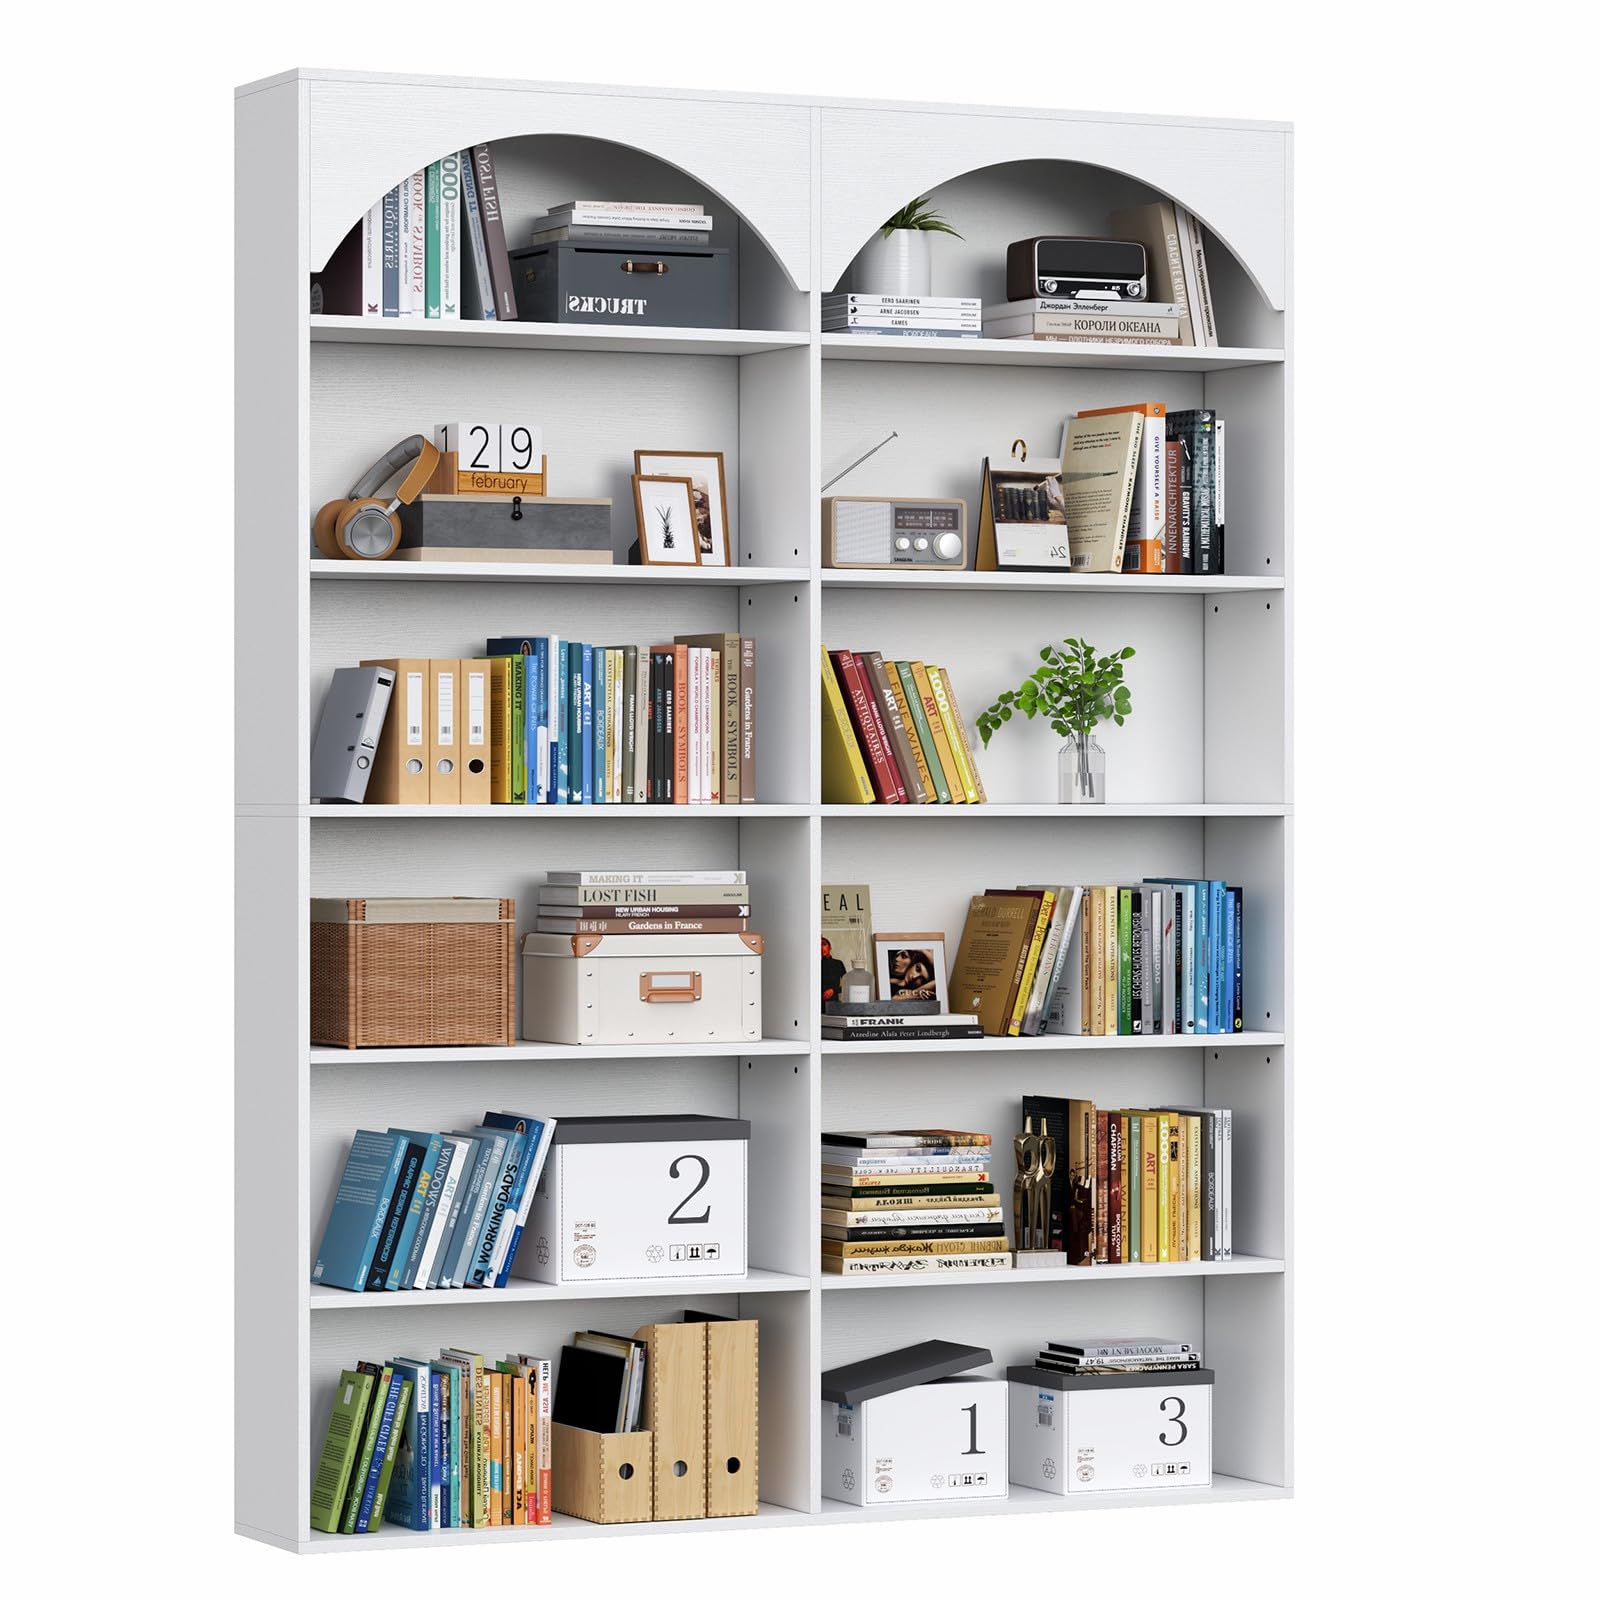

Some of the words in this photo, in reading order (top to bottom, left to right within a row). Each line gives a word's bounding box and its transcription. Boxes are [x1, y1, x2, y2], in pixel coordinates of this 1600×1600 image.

[1166, 233, 1181, 278] СПАСИТЕ
[1040, 301, 1071, 310] Джордан
[1073, 302, 1109, 312] Элленберг
[1074, 319, 1116, 332] КОРОЛИ
[1118, 320, 1161, 333] ОКЕАНА
[471, 472, 528, 494] february
[1124, 478, 1132, 512] RAYMOND
[1168, 449, 1177, 554] INNENARCHITEKTUR
[1182, 491, 1190, 526] GRAVITY'S
[1119, 514, 1128, 551] CHANDLER
[1182, 526, 1190, 559] RAINBOW
[514, 661, 522, 694] MAKING
[727, 673, 737, 708] BOOK
[928, 671, 950, 713] 1000
[515, 698, 522, 710] IT
[583, 681, 592, 708] ART
[678, 682, 686, 714] BOOK
[744, 687, 752, 720] Gardens
[882, 688, 898, 712] ART
[923, 696, 939, 717] ART
[596, 710, 605, 750] BORDEAUX
[745, 721, 752, 730] in
[854, 688, 884, 763] ANTIQUAIRES
[870, 701, 880, 719] FRANK
[882, 736, 892, 756] WRIGHT
[890, 681, 910, 719] FINE
[905, 726, 930, 785] WINES
[678, 726, 686, 783] SYMBOLS
[727, 720, 737, 781] SYMBOLS
[744, 731, 752, 759] France
[589, 874, 630, 884] MAKING
[633, 874, 643, 883] IT
[583, 889, 622, 902] LOST
[624, 889, 657, 902] FISH
[628, 921, 663, 930] Gardens
[664, 921, 673, 929] in
[674, 921, 703, 930] France
[850, 1030, 879, 1038] Azzedine
[917, 1028, 950, 1038] Lindbergh
[860, 1017, 904, 1026] FRANK
[1160, 1120, 1169, 1164] 1000
[403, 1157, 418, 1189] GRAPHIC
[425, 1148, 452, 1208] WINDOWS
[1146, 1152, 1156, 1175] ART
[416, 1170, 431, 1197] ART
[443, 1175, 457, 1200] ART
[479, 1182, 491, 1208] Gardens
[667, 1154, 711, 1225] 2
[371, 1197, 389, 1239] BORDEAUX
[395, 1190, 408, 1216] DESIGN
[478, 1202, 505, 1264] WORKING
[496, 1163, 518, 1204] DAD'S
[465, 1217, 480, 1247] France
[1177, 1362, 1197, 1370] SARA
[960, 1402, 986, 1456] 1
[1158, 1396, 1188, 1447] 3
